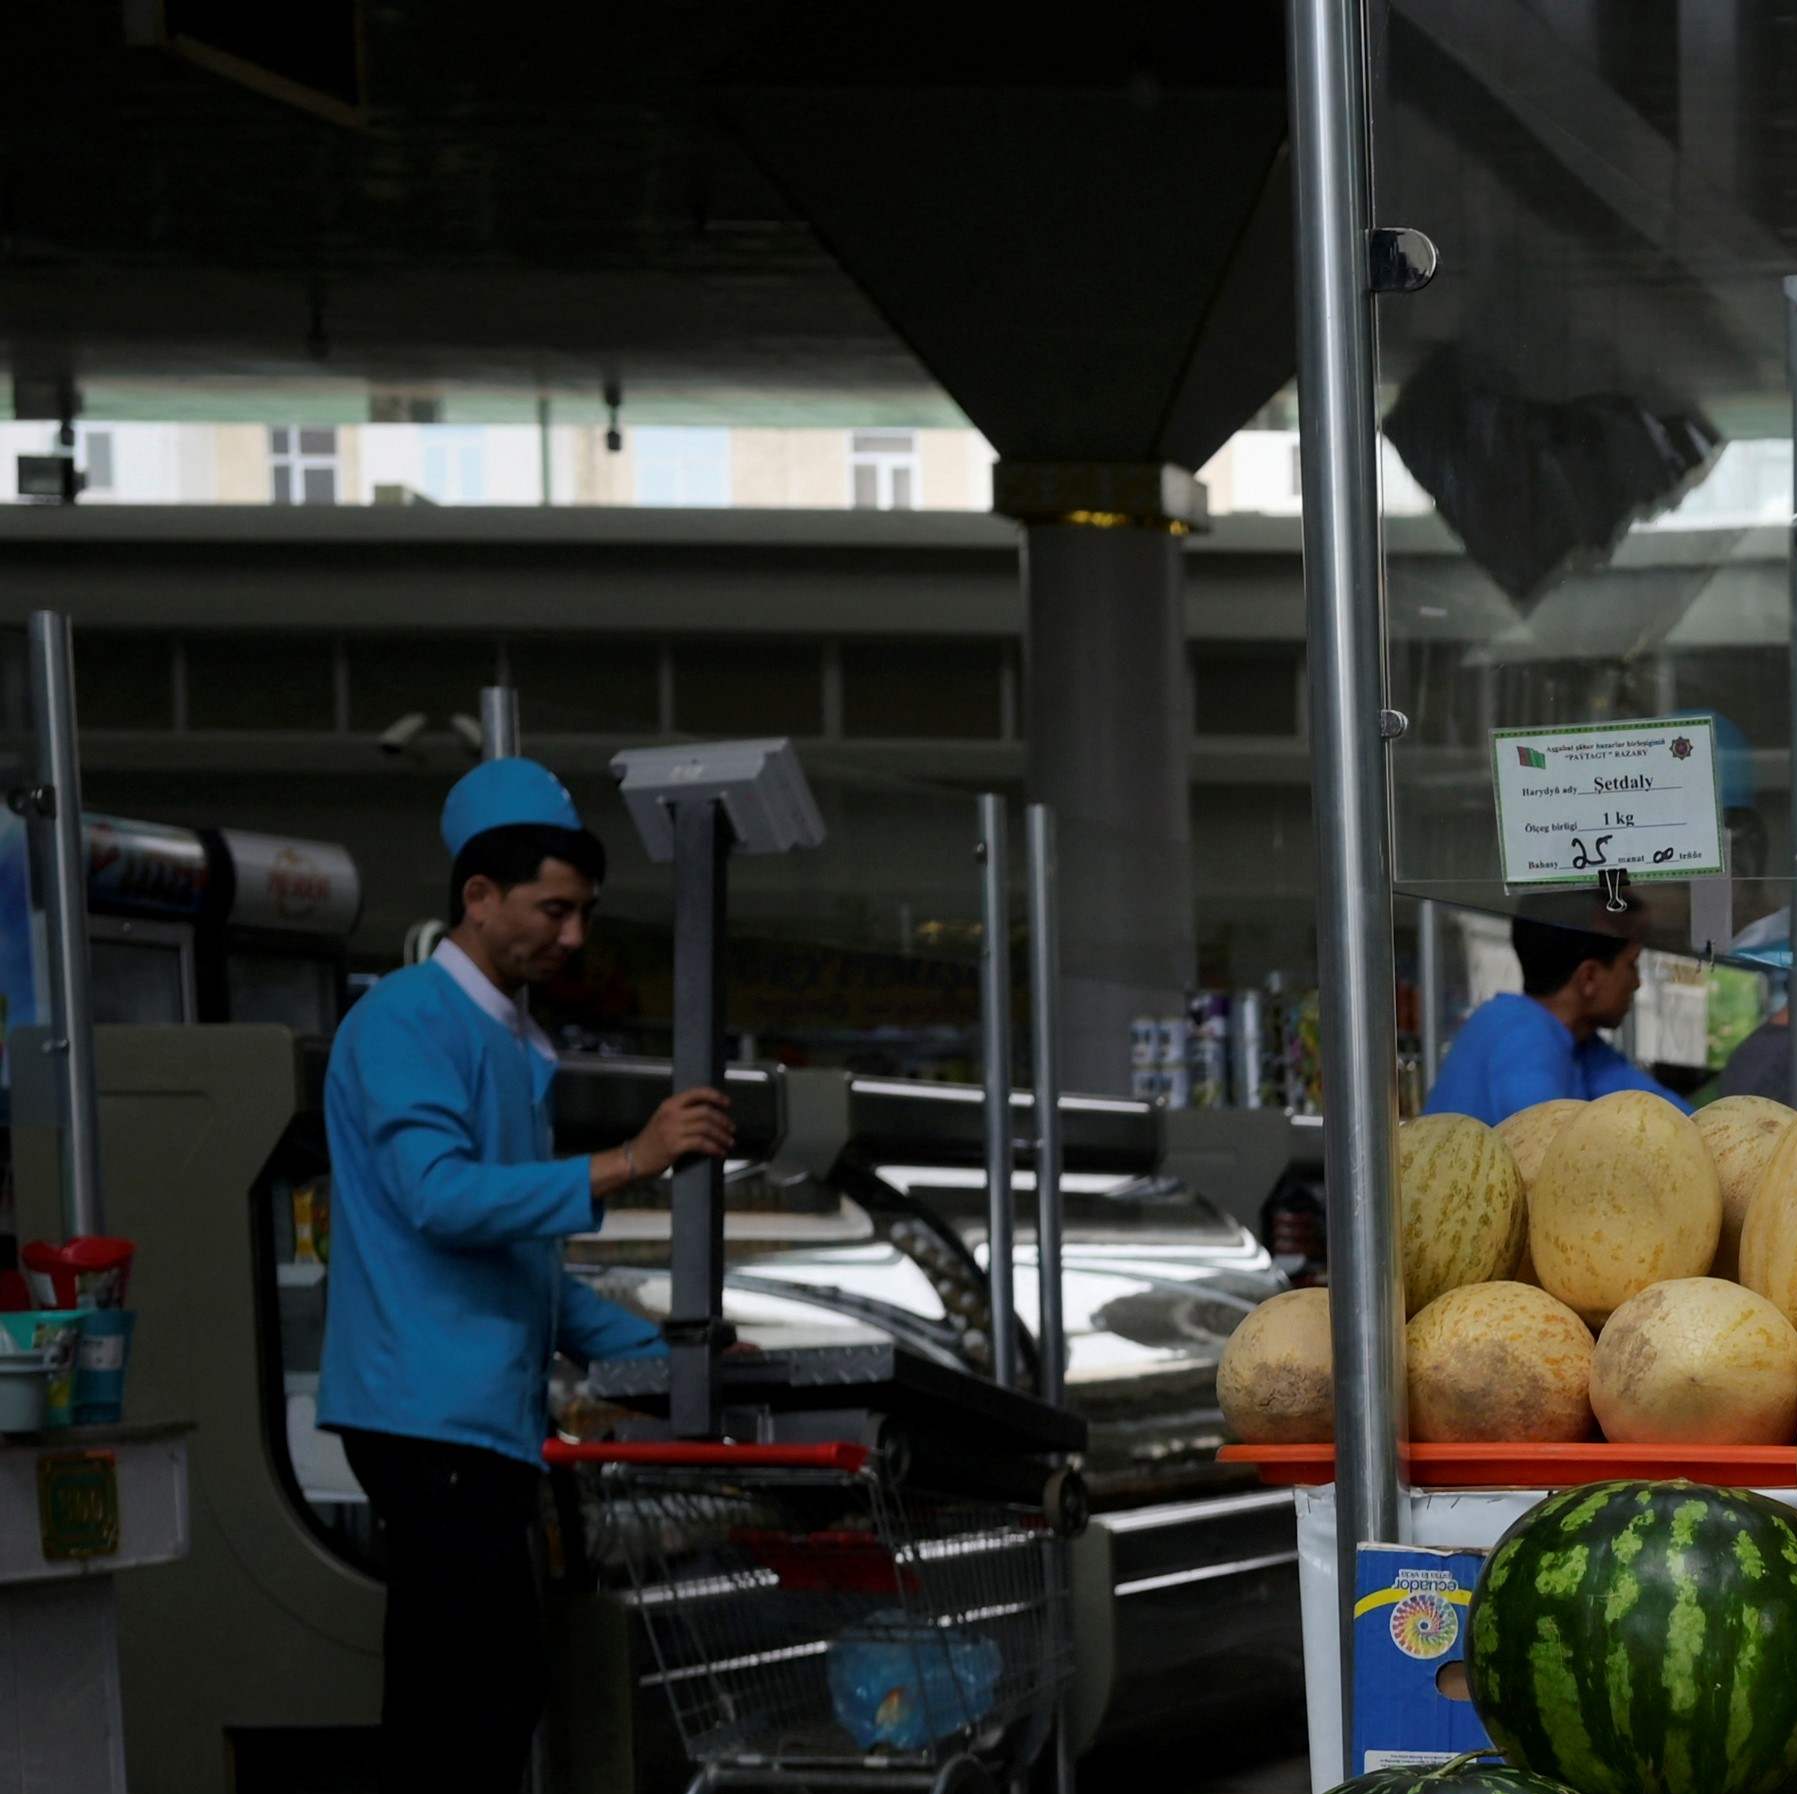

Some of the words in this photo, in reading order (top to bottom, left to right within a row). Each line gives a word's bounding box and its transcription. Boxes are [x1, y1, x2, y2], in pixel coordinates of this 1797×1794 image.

[1562, 785, 1578, 796] ady
[1525, 822, 1550, 834] Ölçeg
[1603, 812, 1610, 826] 1
[1616, 811, 1635, 827] kg
[1571, 834, 1613, 870] 25
[1618, 855, 1645, 864] manat
[1653, 847, 1674, 864] 00
[1394, 1580, 1458, 1593] ecuador
